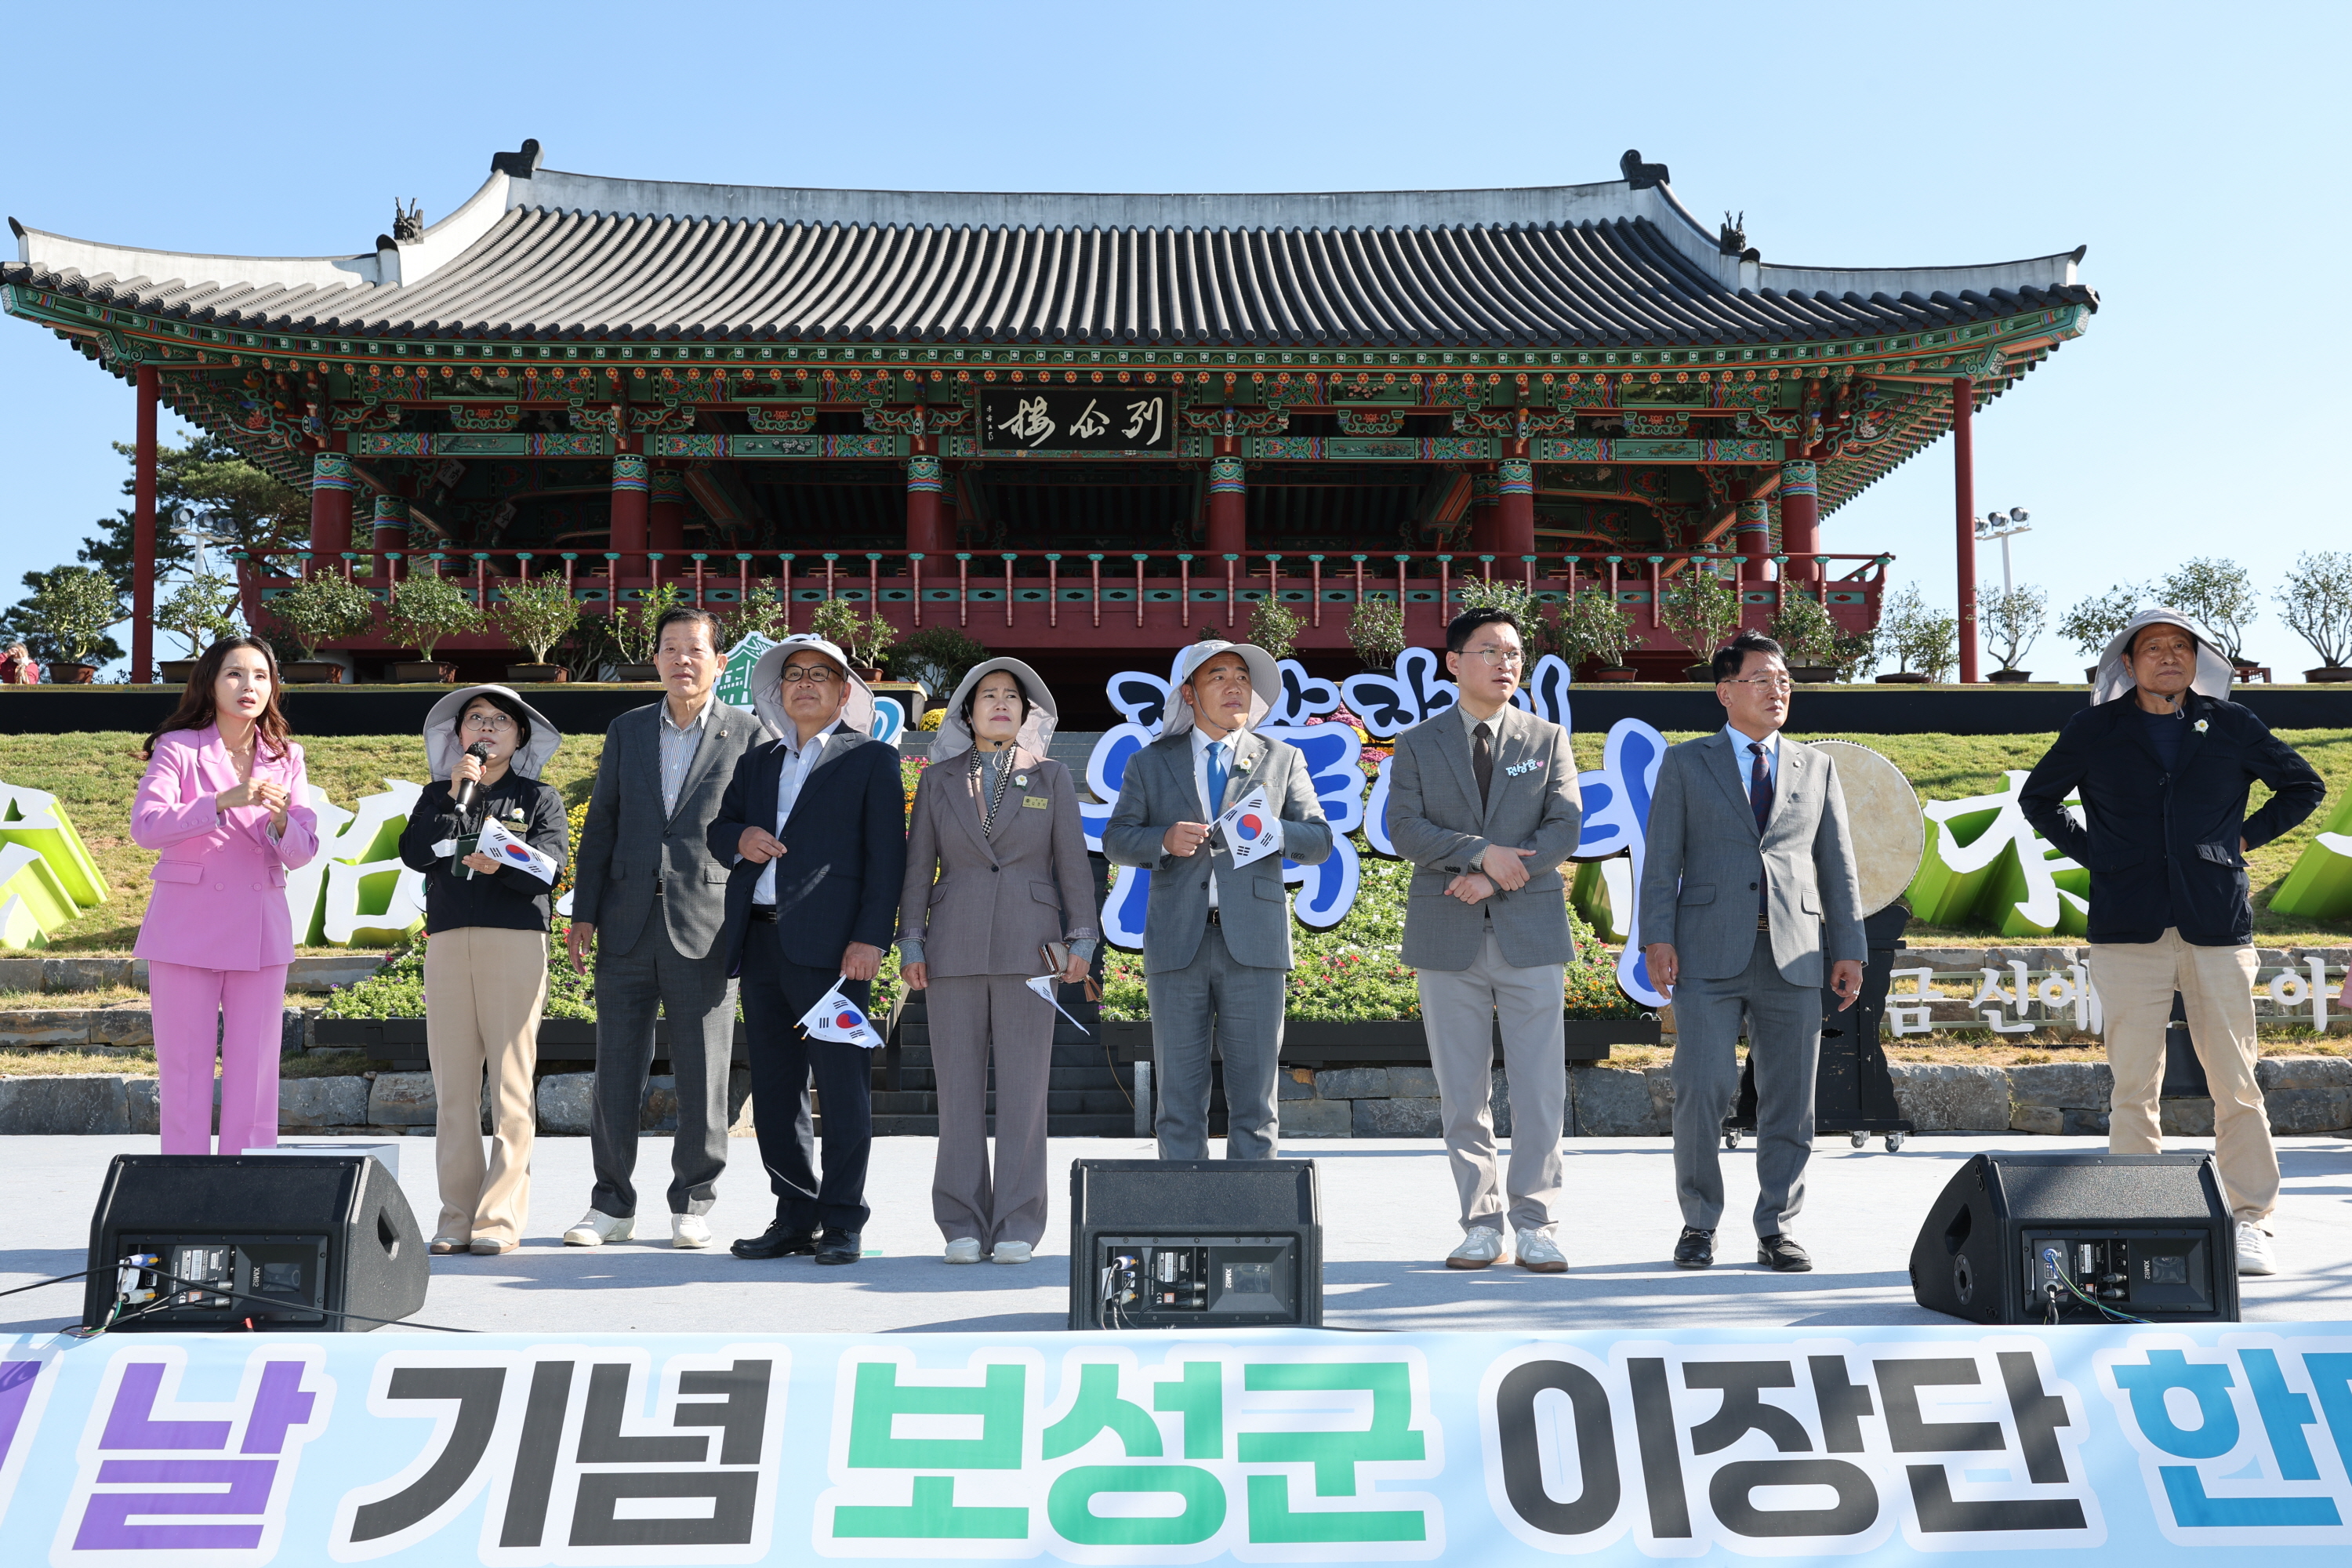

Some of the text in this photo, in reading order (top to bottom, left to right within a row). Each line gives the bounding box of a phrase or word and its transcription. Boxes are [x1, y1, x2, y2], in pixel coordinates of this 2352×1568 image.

[1505, 759, 1537, 776] 전상호
[1885, 956, 2350, 1037] 금 신에 아
[72, 1360, 317, 1551] 날
[348, 1359, 772, 1549] 기념
[831, 1359, 1426, 1546] 보성군
[1494, 1351, 2088, 1541] 이장단
